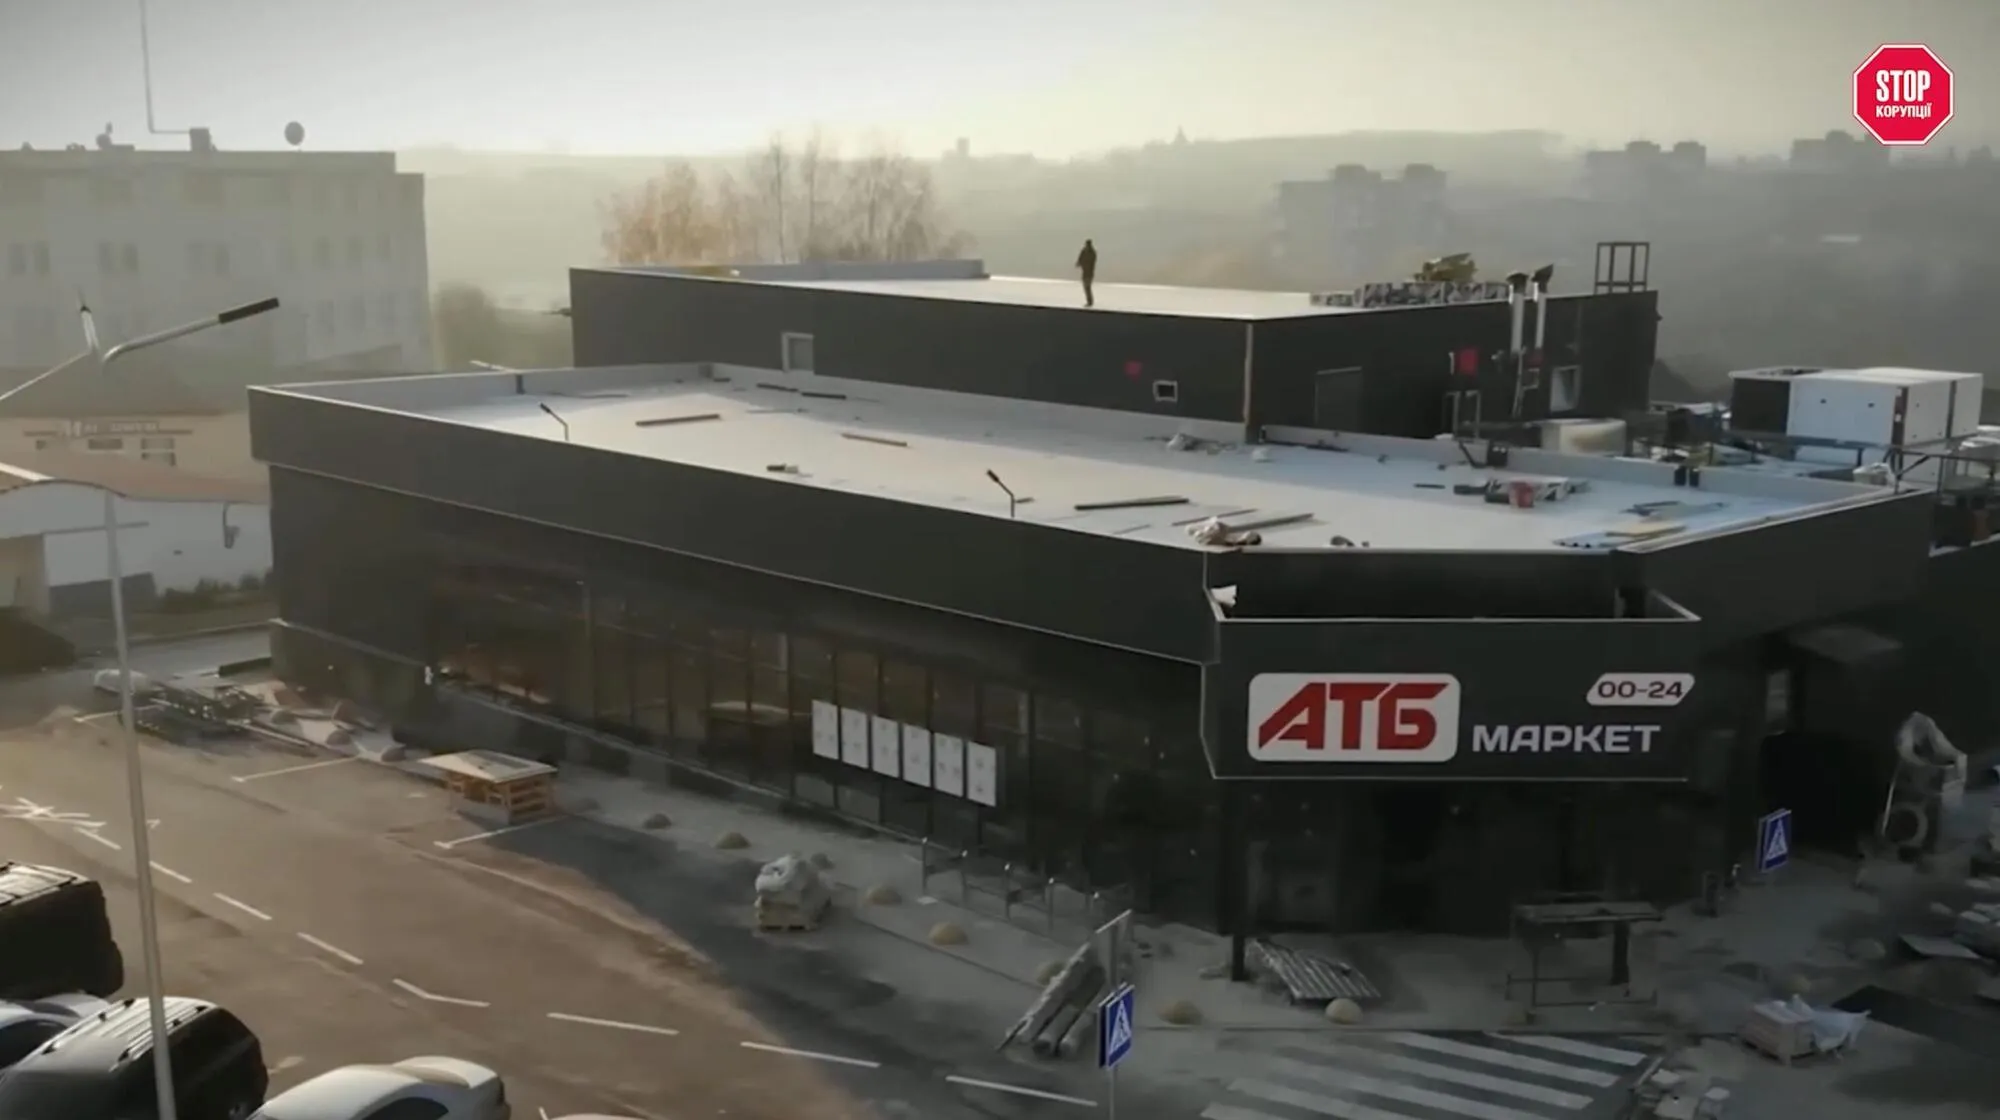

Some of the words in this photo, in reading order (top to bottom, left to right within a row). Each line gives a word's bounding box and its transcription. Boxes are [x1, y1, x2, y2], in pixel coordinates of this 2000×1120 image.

[1597, 680, 1684, 699] 00-24
[1258, 682, 1450, 751] АТБ
[1471, 724, 1661, 753] МАРКЕТ
